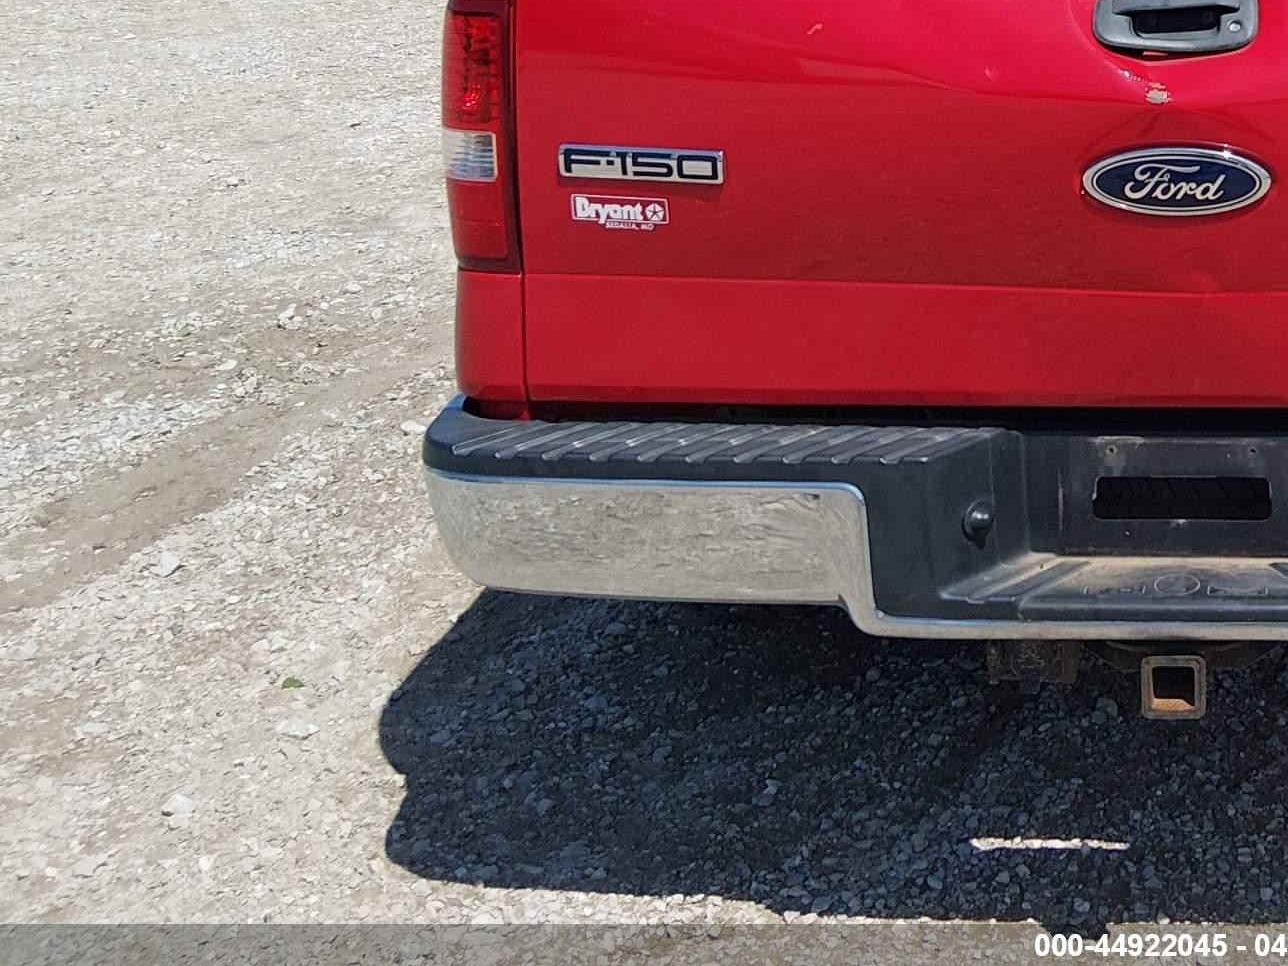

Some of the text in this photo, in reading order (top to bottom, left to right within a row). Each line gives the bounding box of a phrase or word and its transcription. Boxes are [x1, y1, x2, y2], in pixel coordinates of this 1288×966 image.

[563, 148, 719, 181] F-150
[1124, 163, 1226, 201] Ford
[575, 196, 644, 224] Bryant
